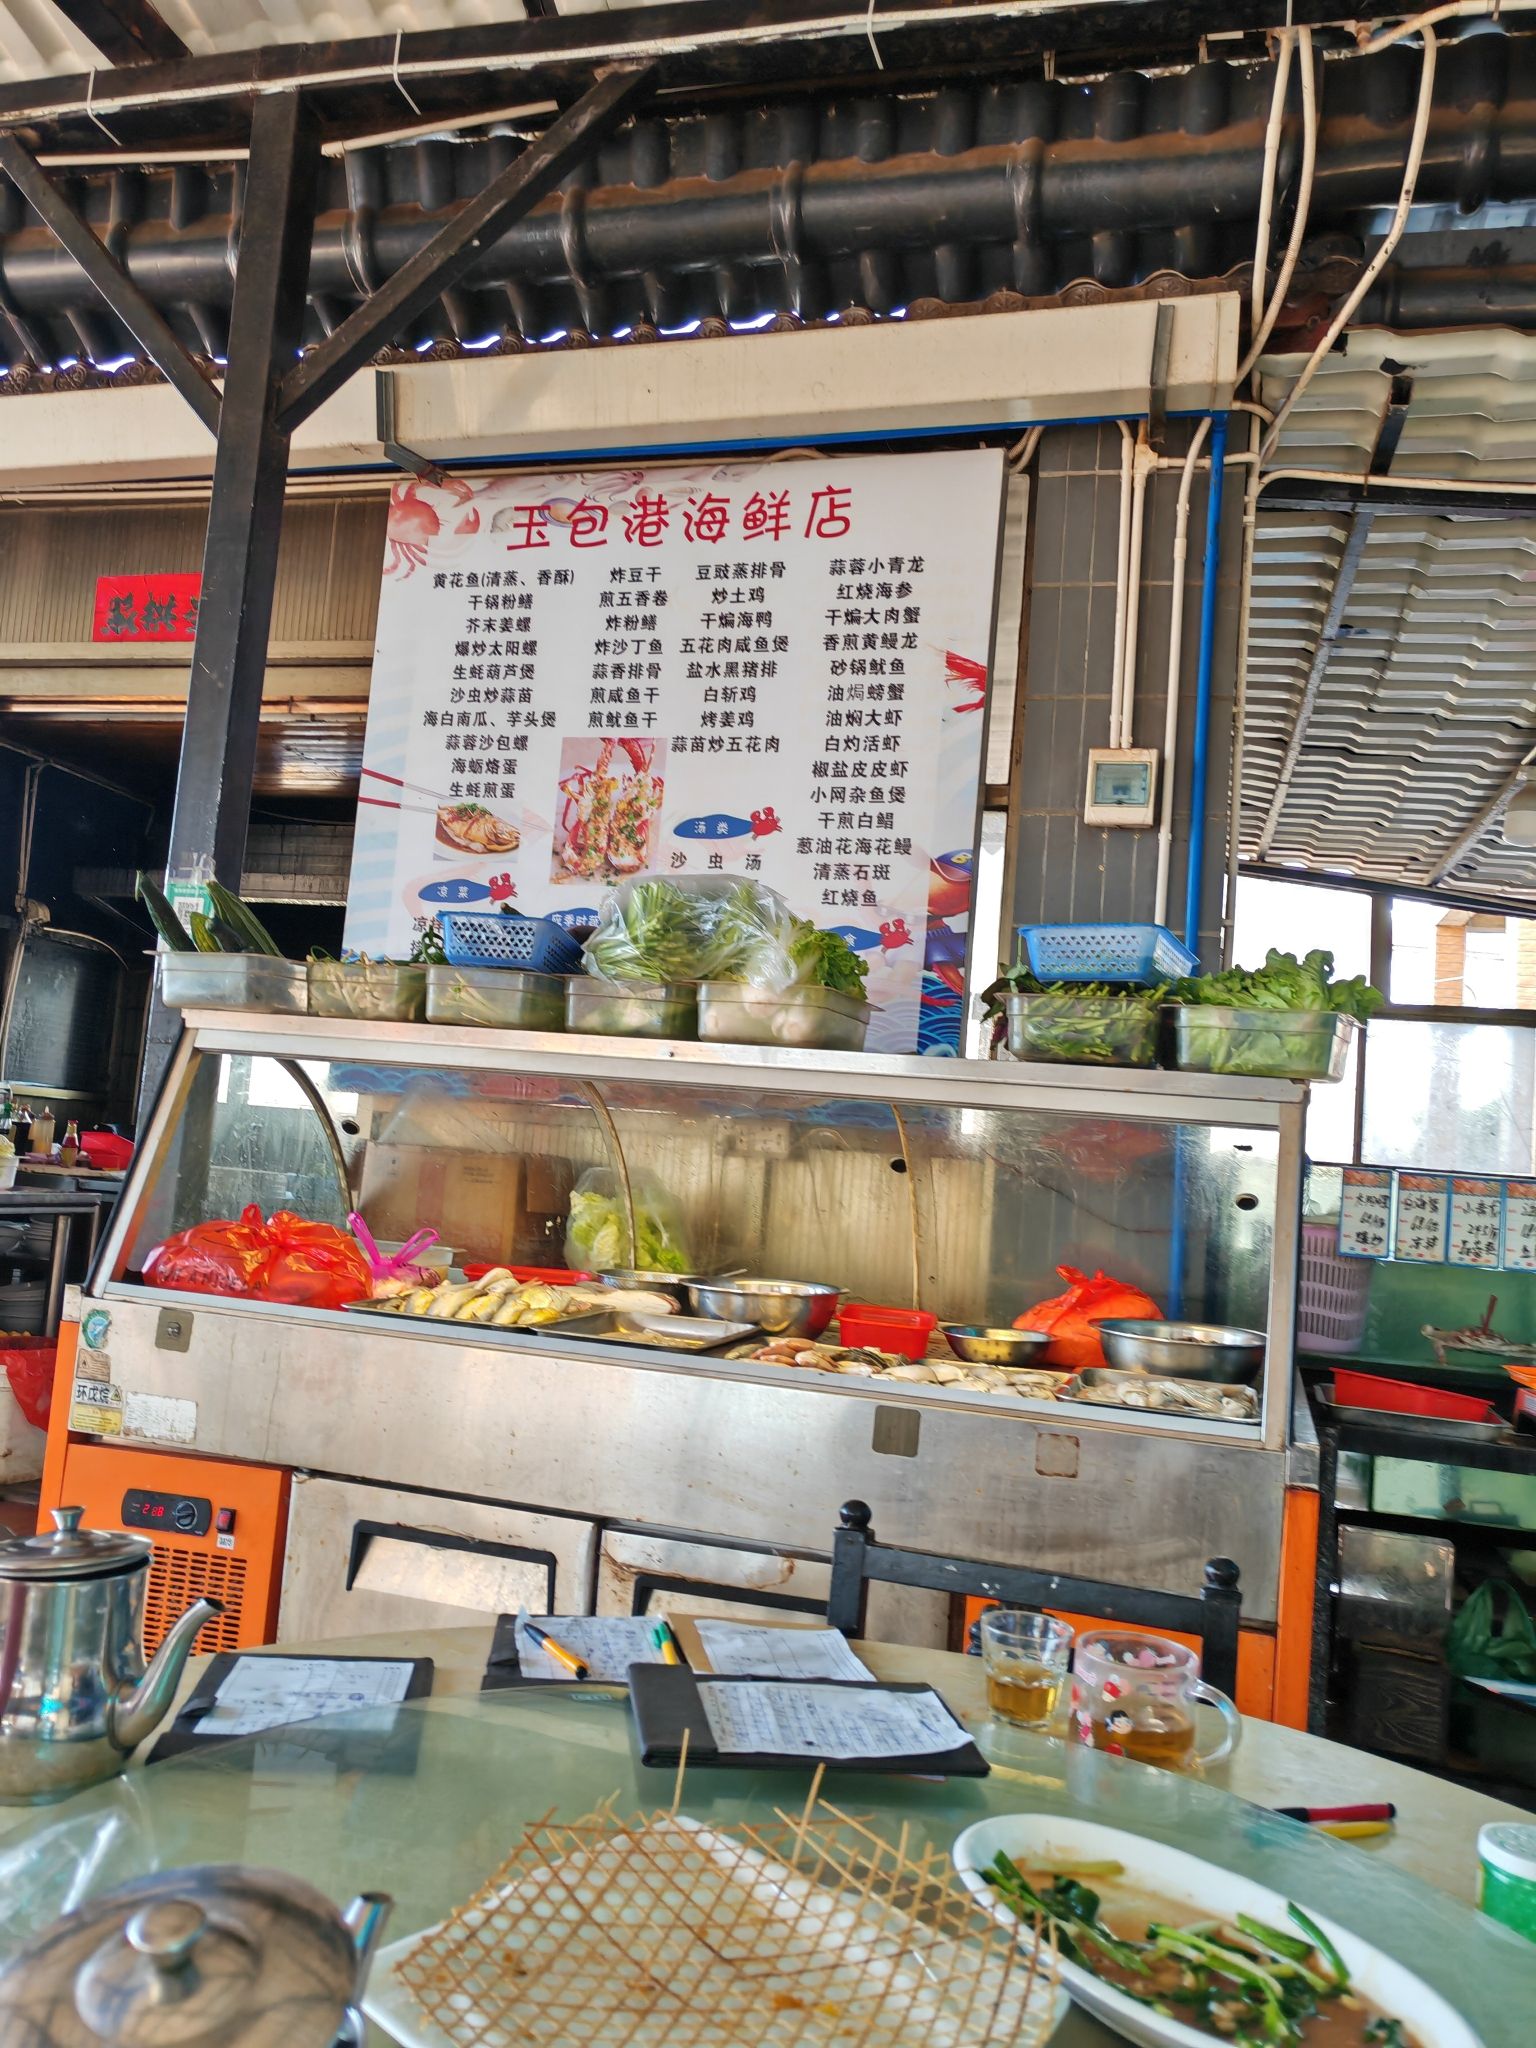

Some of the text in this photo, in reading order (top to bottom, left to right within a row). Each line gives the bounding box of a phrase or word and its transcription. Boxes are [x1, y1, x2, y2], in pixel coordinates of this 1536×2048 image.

[506, 485, 853, 551] 玉包港海鲜店
[696, 561, 786, 580] 豆豉蒸排骨
[829, 556, 925, 576] 蒜蓉小青龙
[610, 567, 661, 584] 炸豆干
[711, 586, 764, 604] 炒土鸡
[836, 581, 912, 600] 红烧海参
[466, 617, 531, 633] 芥末姜螺
[700, 610, 772, 629] 干煸海鸭
[825, 606, 920, 626] 干煸大肉蟹
[455, 640, 537, 656] 爆炒太阳螺
[594, 638, 663, 655] 炸沙丁鱼
[680, 635, 789, 654] 五花肉咸鱼煲
[453, 664, 535, 680] 生蚝葫芦煲
[592, 663, 661, 679] 蒜香排骨
[686, 660, 778, 678] 盐水黑猪排
[830, 658, 905, 676] 砂锅鱿鱼
[450, 687, 533, 704] 沙虫炒蒜苗
[590, 687, 659, 704] 煎咸鱼干
[704, 685, 756, 703] 白斩鸡
[828, 683, 904, 701] 油焗螃蟹
[588, 711, 657, 728] 煎鱿鱼干
[701, 710, 754, 728] 烤姜鸡
[826, 709, 903, 727] 油焖大虾
[445, 734, 528, 751] 蒜蓉沙包螺
[671, 735, 779, 753] 蒜苗炒五花肉
[825, 734, 901, 752] 白灼活虾
[812, 760, 909, 778] 椒盐皮皮虾
[449, 781, 515, 798] 生蚝煎蛋
[810, 786, 906, 804] 小网杂鱼煲
[818, 812, 894, 829] 干煎白鲳
[796, 837, 912, 855] 葱油花海花鳗
[671, 852, 761, 871] 沙虫汤
[813, 863, 890, 880] 清蒸石斑
[821, 889, 878, 907] 红烧鱼
[76, 1384, 110, 1404] 环戊烷
